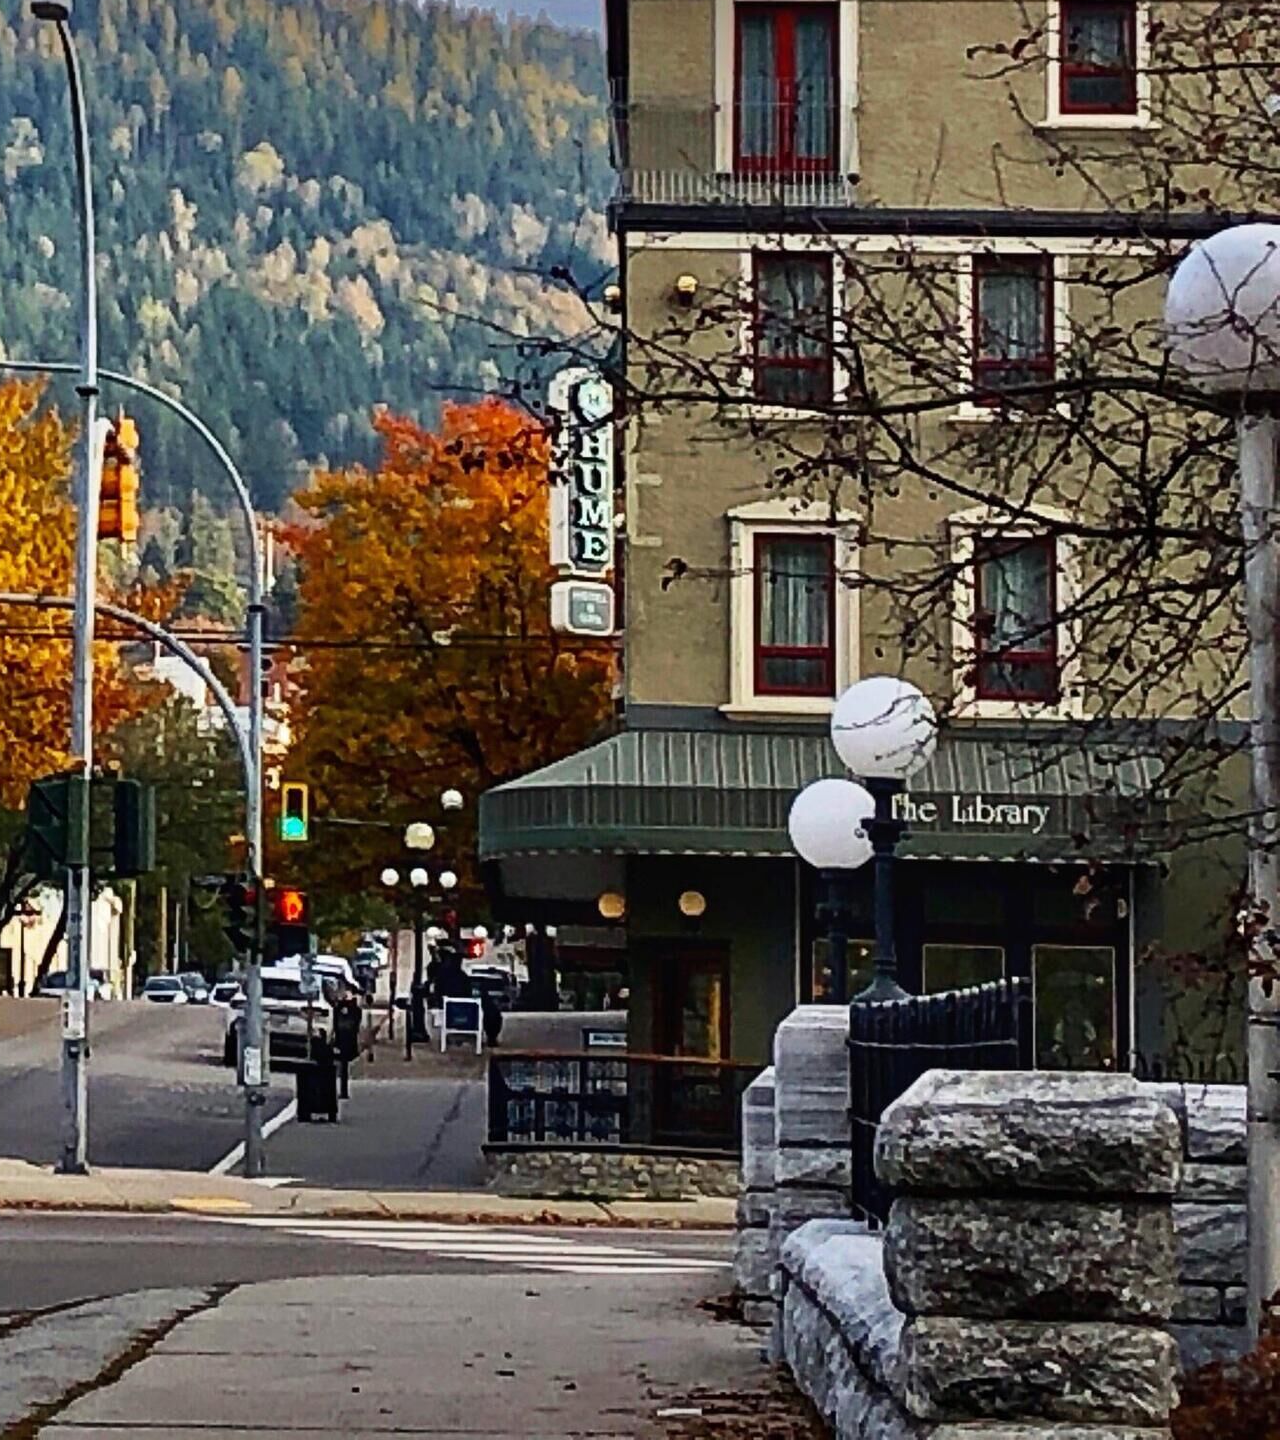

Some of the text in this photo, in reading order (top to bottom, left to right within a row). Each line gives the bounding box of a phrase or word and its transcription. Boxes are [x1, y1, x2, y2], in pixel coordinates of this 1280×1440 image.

[578, 426, 610, 561] HUME
[891, 793, 1049, 834] The Library
